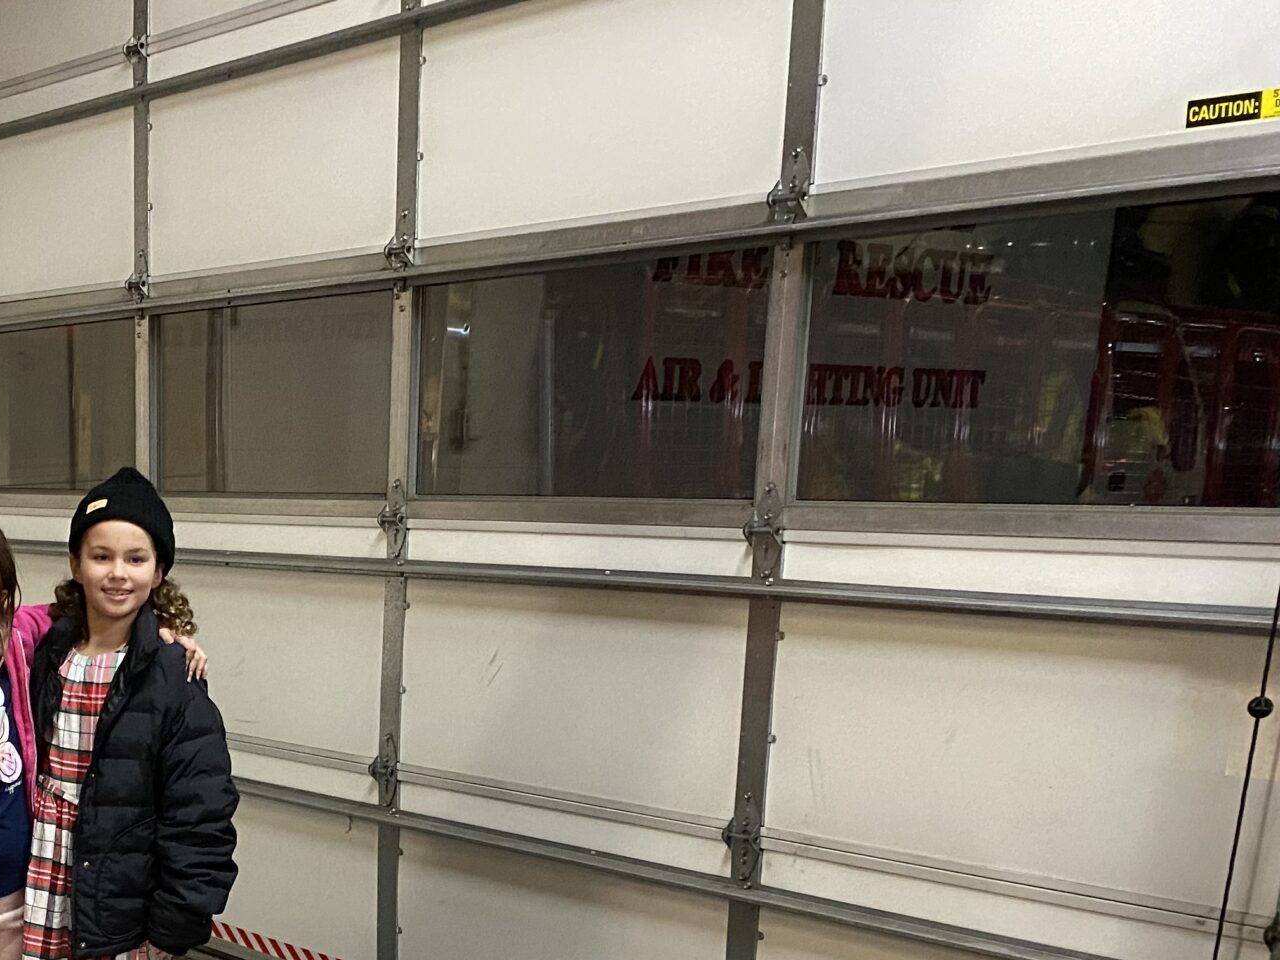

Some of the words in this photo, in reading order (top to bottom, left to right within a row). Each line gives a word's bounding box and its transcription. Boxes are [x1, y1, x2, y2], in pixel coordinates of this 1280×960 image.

[1188, 98, 1259, 123] CAUTION:
[831, 239, 995, 305] RESCUE
[631, 355, 702, 402] AIR
[709, 359, 741, 404] &
[911, 367, 986, 409] UNIT
